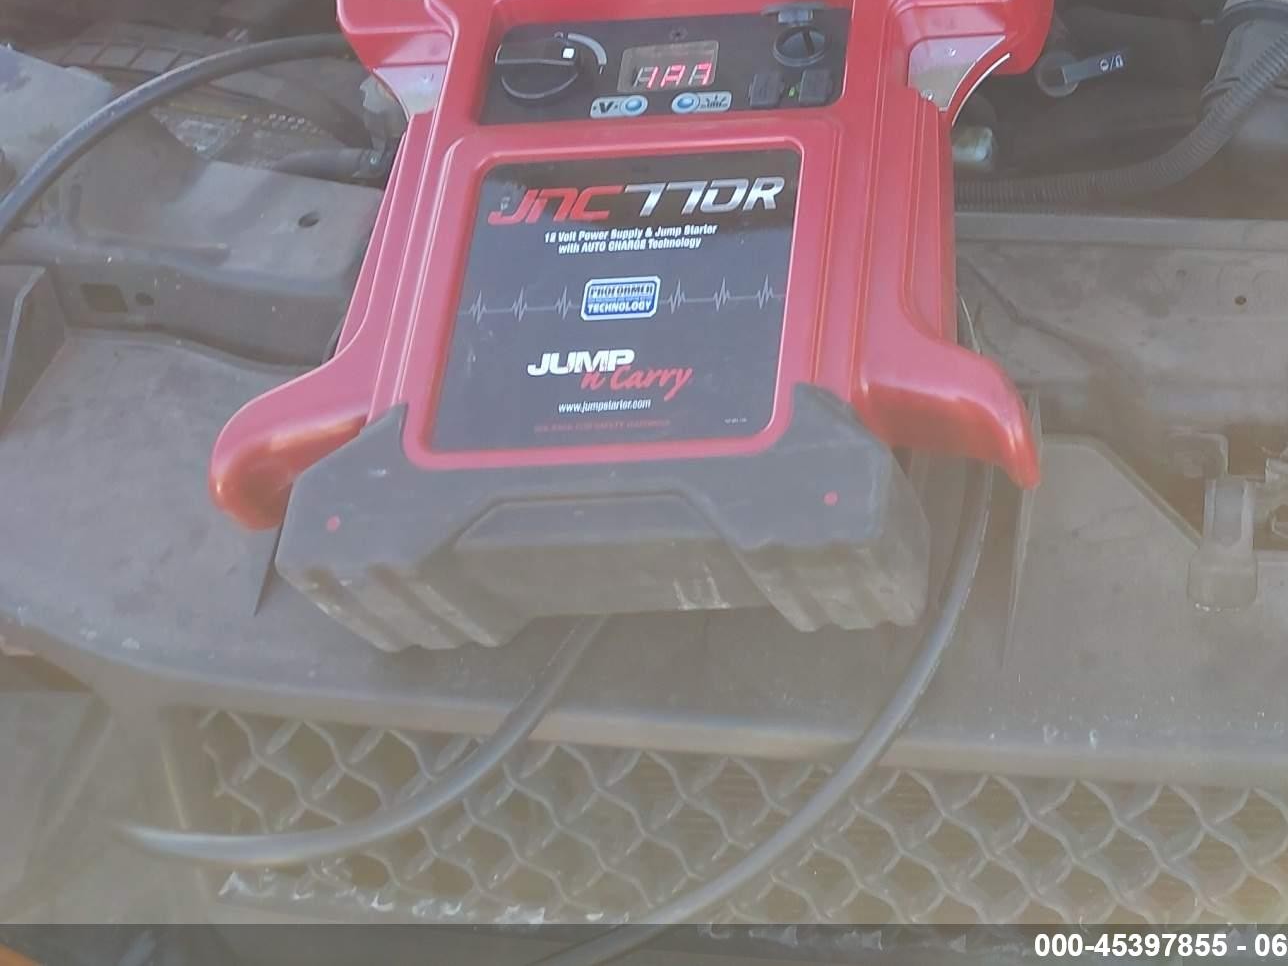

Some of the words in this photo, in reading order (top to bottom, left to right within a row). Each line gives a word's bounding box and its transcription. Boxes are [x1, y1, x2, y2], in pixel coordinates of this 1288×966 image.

[558, 231, 576, 241] Volt
[578, 230, 609, 240] Power
[645, 227, 653, 237] &
[655, 225, 682, 237] Jump
[559, 243, 580, 253] with
[581, 242, 606, 252] AUTO
[648, 237, 702, 249] Technology
[587, 300, 652, 314] TECHNOLOGY
[527, 349, 634, 376] JUMP
[610, 366, 694, 401] Carry
[558, 399, 651, 413] www.jumpstarter.com
